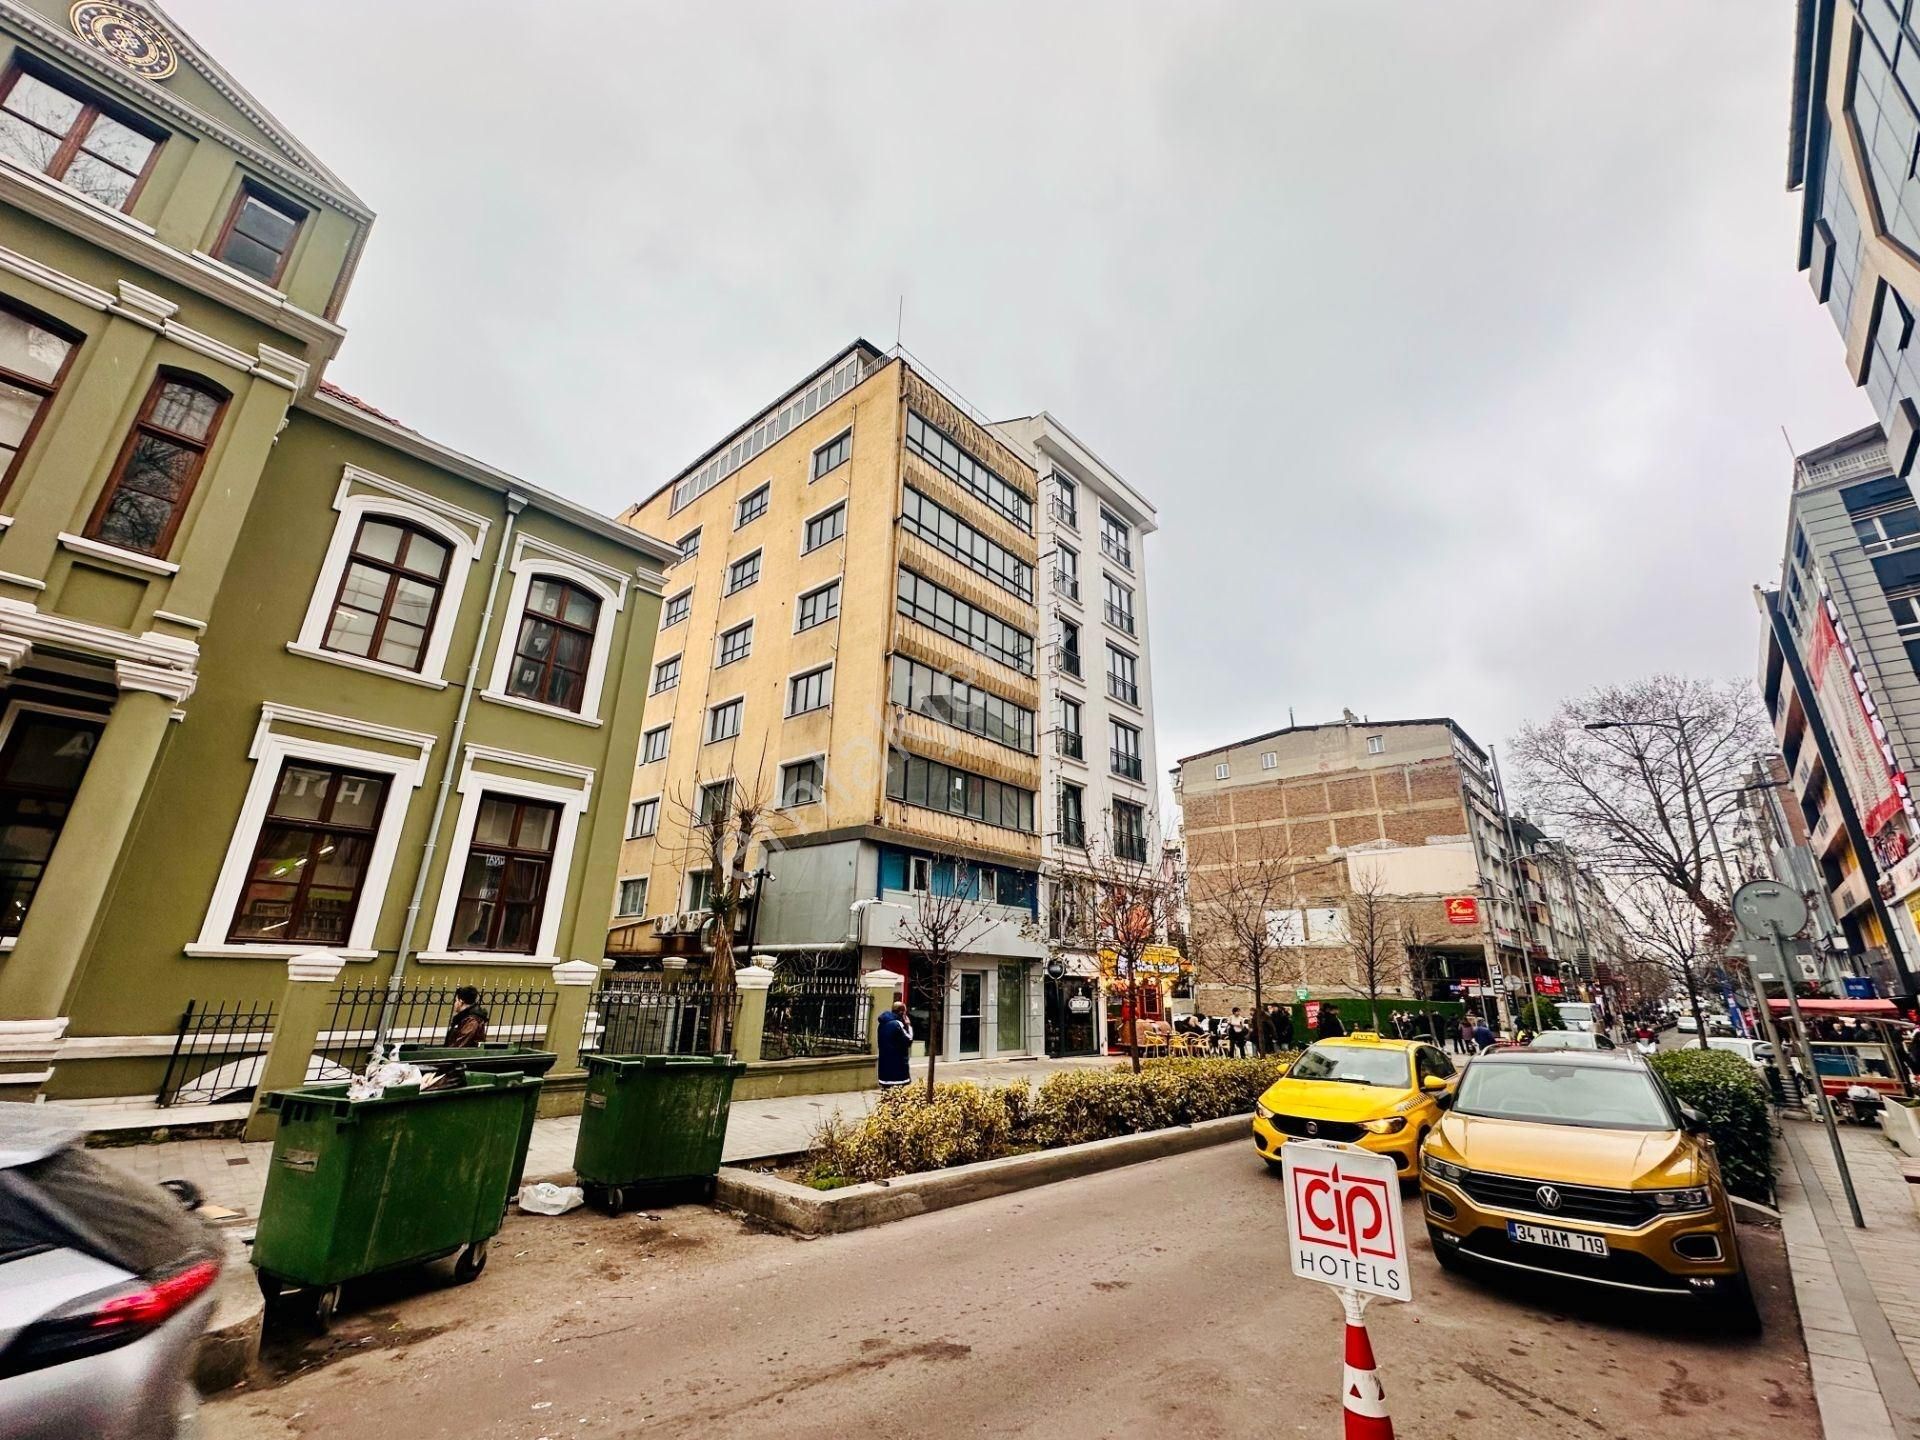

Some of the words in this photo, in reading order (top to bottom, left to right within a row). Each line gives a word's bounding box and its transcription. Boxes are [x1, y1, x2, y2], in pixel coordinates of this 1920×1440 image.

[1516, 1225, 1535, 1242] 34
[1541, 1229, 1570, 1248] HAM
[1576, 1234, 1605, 1254] 719
[1300, 1250, 1400, 1291] HOTELS
